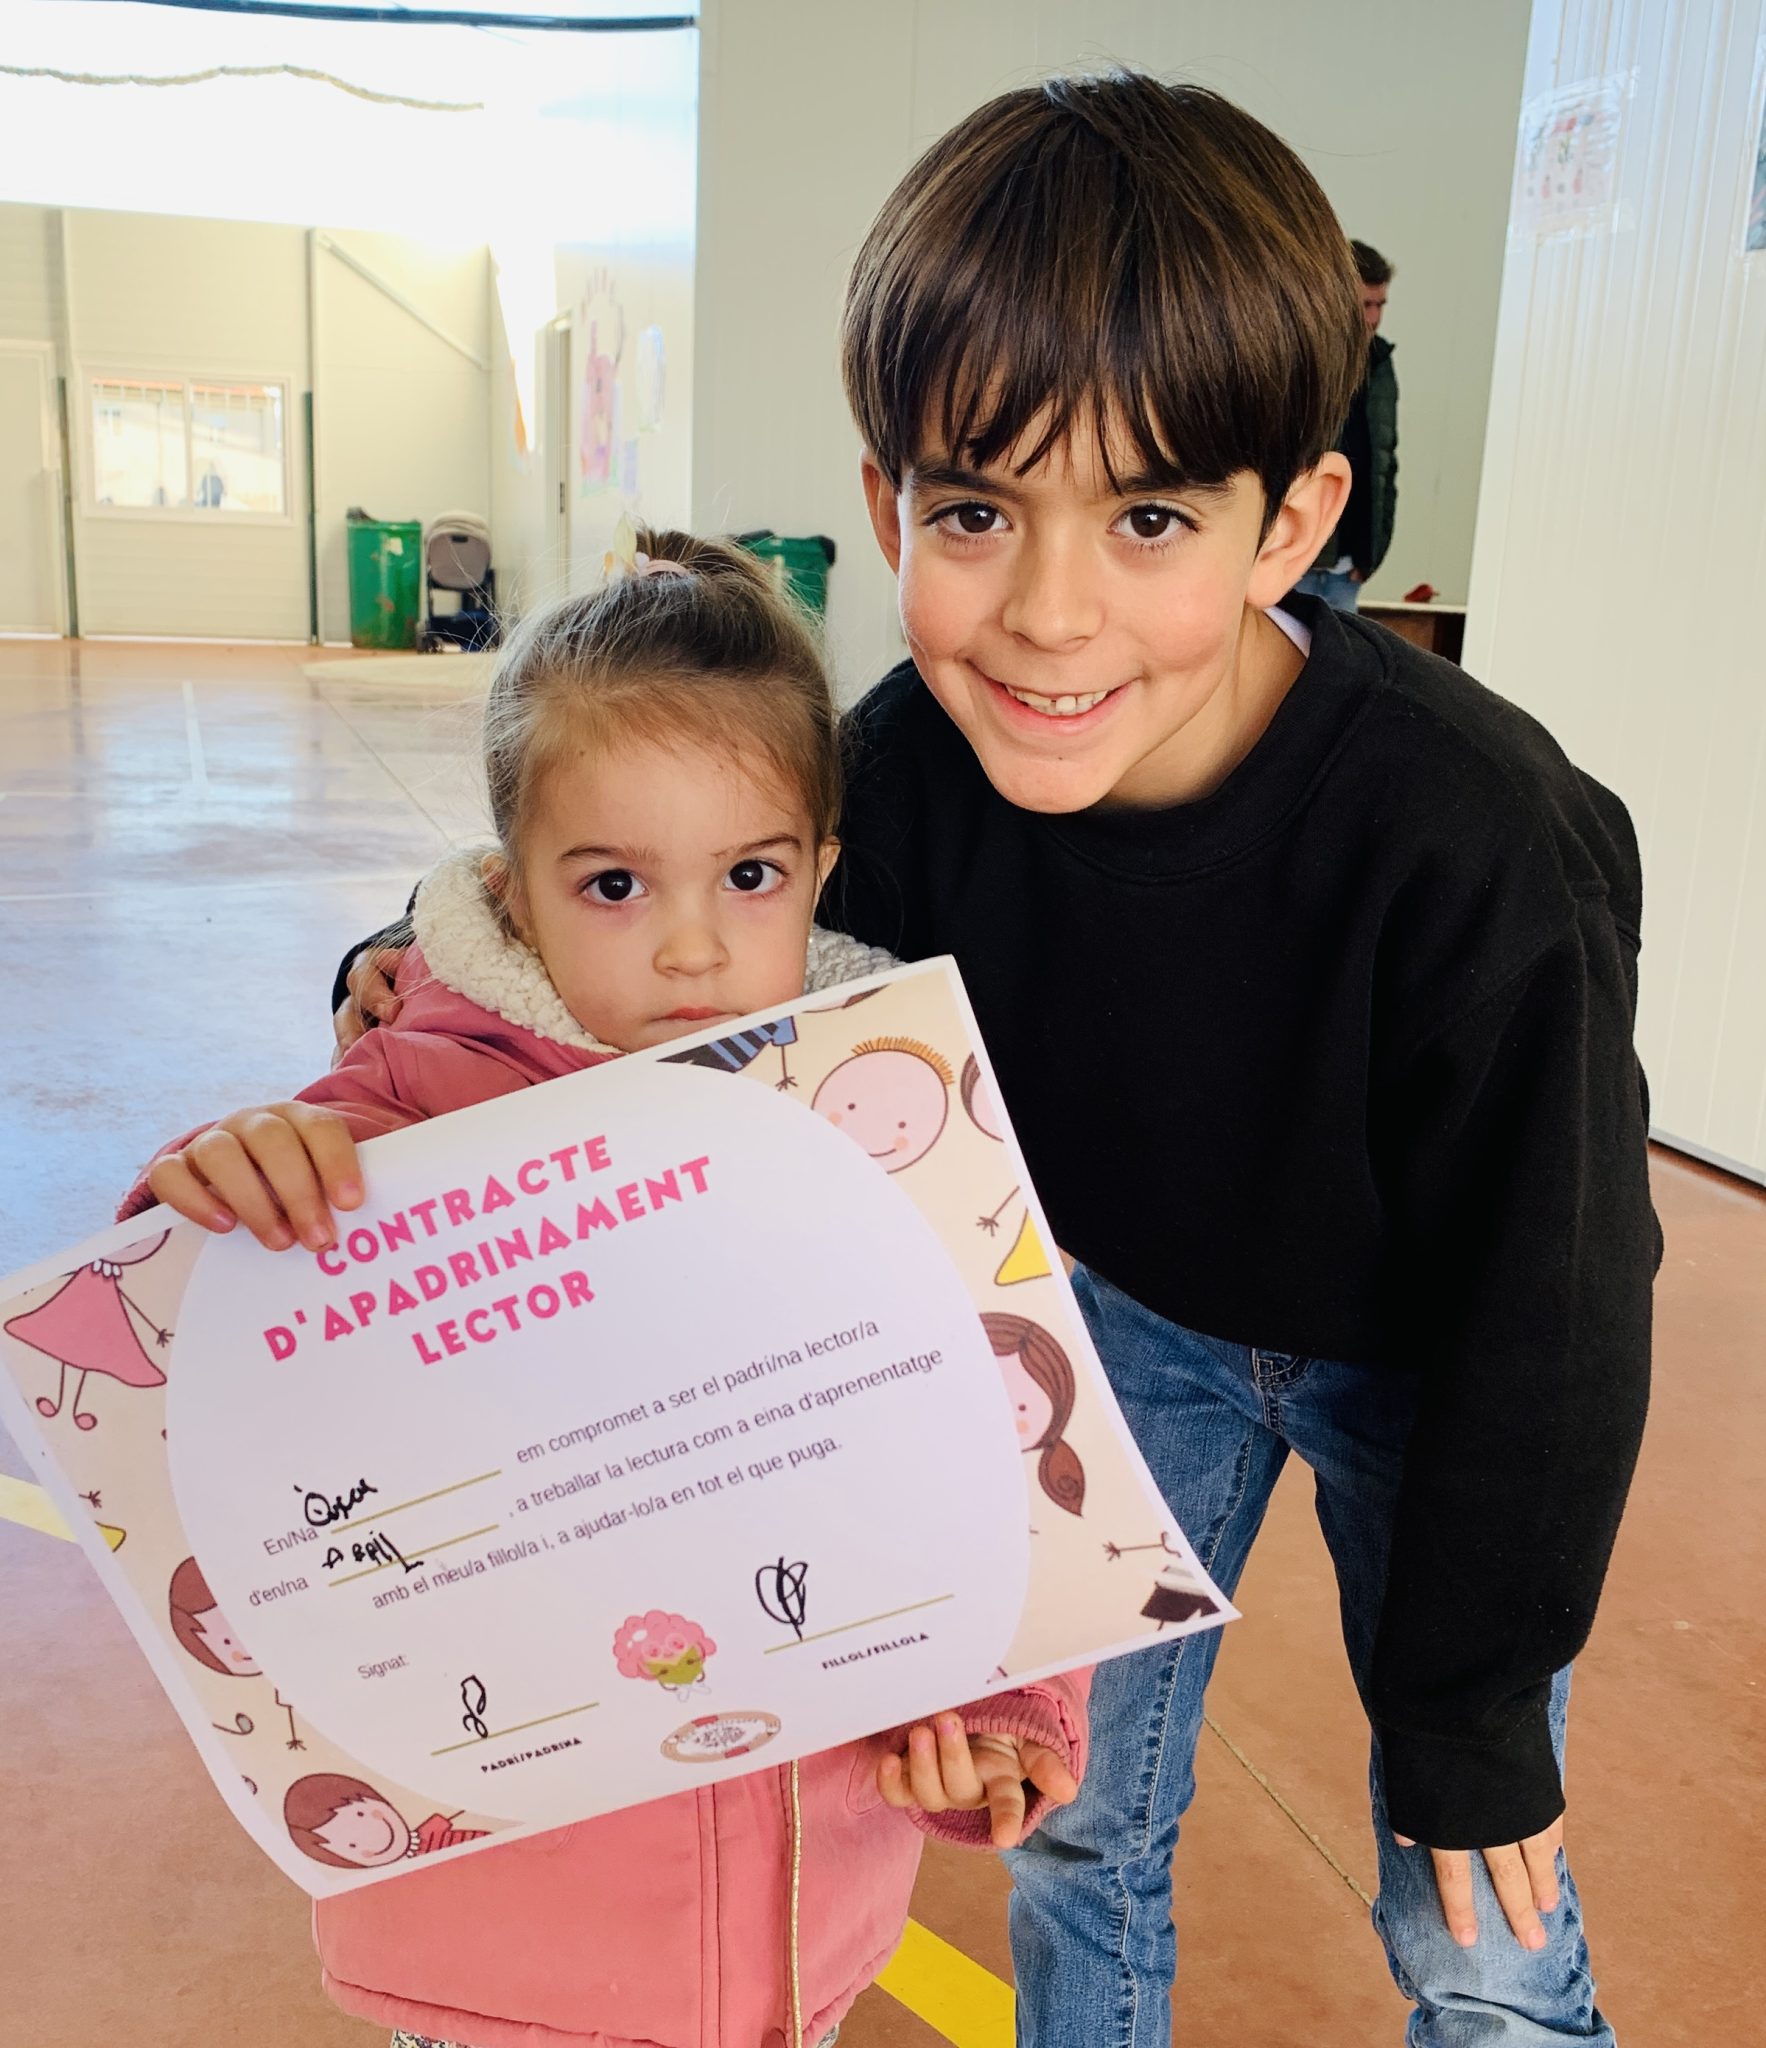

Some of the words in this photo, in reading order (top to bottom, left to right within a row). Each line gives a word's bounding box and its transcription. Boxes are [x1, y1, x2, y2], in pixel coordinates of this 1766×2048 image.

[263, 1156, 710, 1362] D'APADRINAMENT
[316, 1135, 612, 1276] CONTRACTE
[411, 1270, 596, 1365] LECTOR
[249, 1577, 309, 1606] d'en/na
[516, 1498, 529, 1512] a
[530, 1471, 601, 1506] treballar
[604, 1464, 624, 1479] la
[625, 1441, 690, 1472] lectura
[693, 1425, 733, 1448] com
[737, 1419, 750, 1433] a
[754, 1404, 795, 1427] eina
[263, 1527, 319, 1555] En/Na
[517, 1444, 545, 1463] em
[549, 1404, 649, 1451] compromet
[652, 1400, 666, 1414] a
[669, 1387, 697, 1408] ser
[703, 1376, 720, 1395] el
[804, 1321, 879, 1358] lector/a
[372, 1585, 410, 1608] amb
[413, 1576, 430, 1594] el
[432, 1560, 487, 1587] meu/a
[487, 1541, 540, 1567] fillol/a
[557, 1531, 571, 1544] a
[574, 1496, 668, 1539] ajudar-lo/a
[671, 1487, 695, 1504] en
[697, 1475, 724, 1495] tot
[727, 1466, 744, 1485] el
[748, 1456, 783, 1480] que
[821, 1633, 929, 1670] FILLOL/FILLOLA
